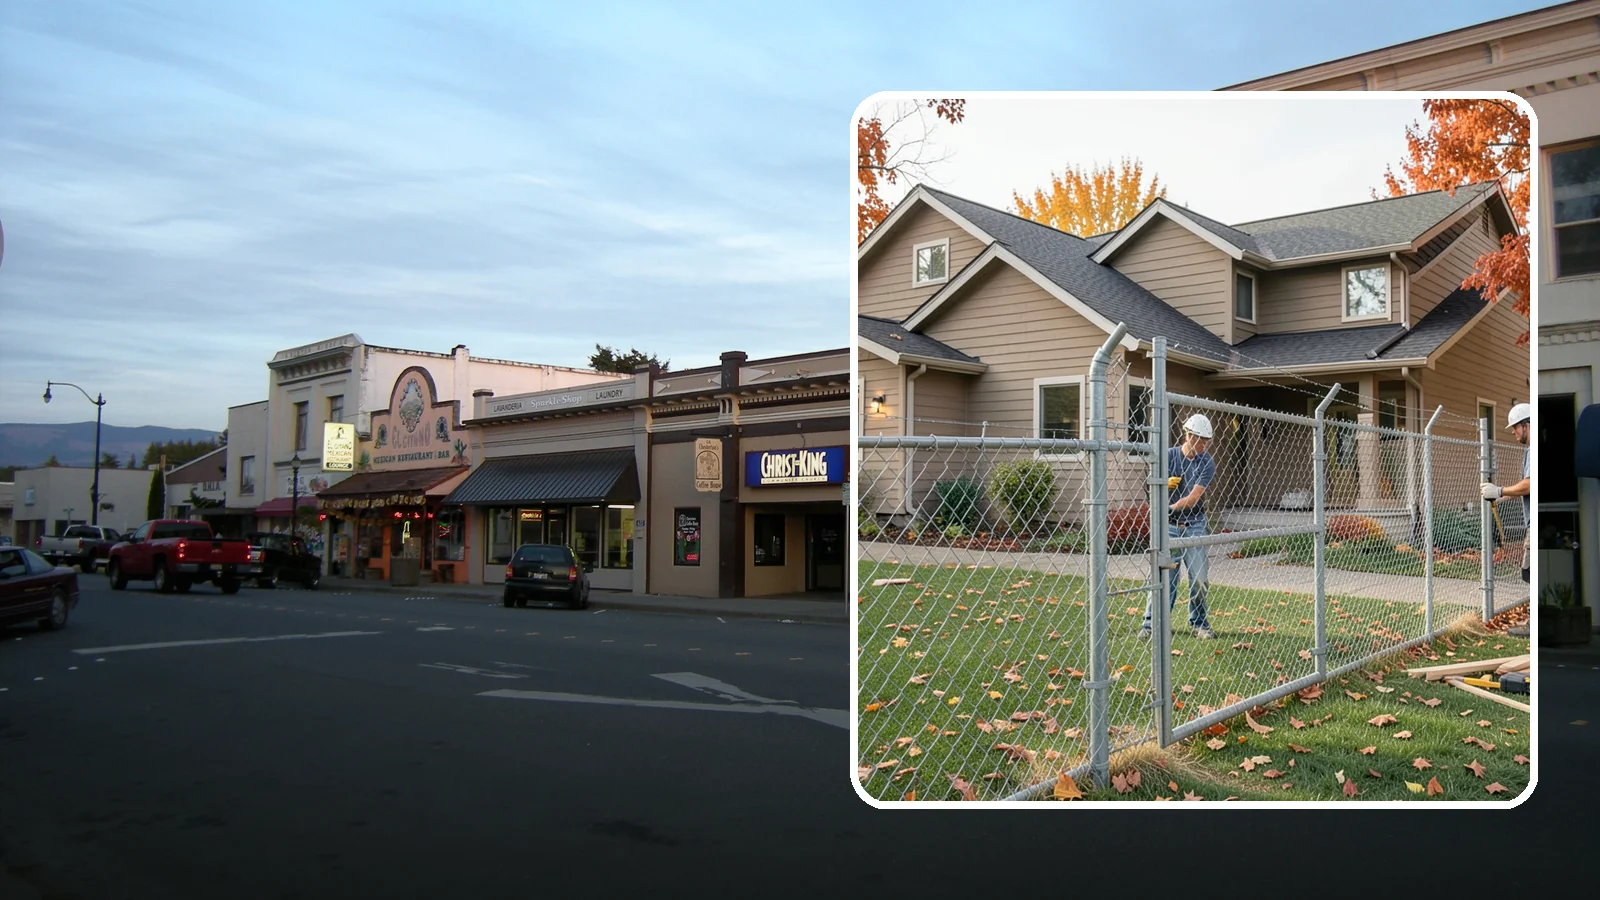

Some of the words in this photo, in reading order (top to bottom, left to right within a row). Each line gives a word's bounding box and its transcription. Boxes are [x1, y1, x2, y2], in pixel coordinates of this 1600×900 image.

[562, 394, 582, 404] Shop
[596, 389, 623, 399] LAUNDRY
[494, 402, 522, 412] LAVANDERIA
[373, 454, 396, 464] MEXICAN
[398, 451, 433, 462] RESTAURANT
[438, 450, 450, 458] BAR
[761, 452, 797, 477] CHRIST
[799, 450, 827, 476] KING
